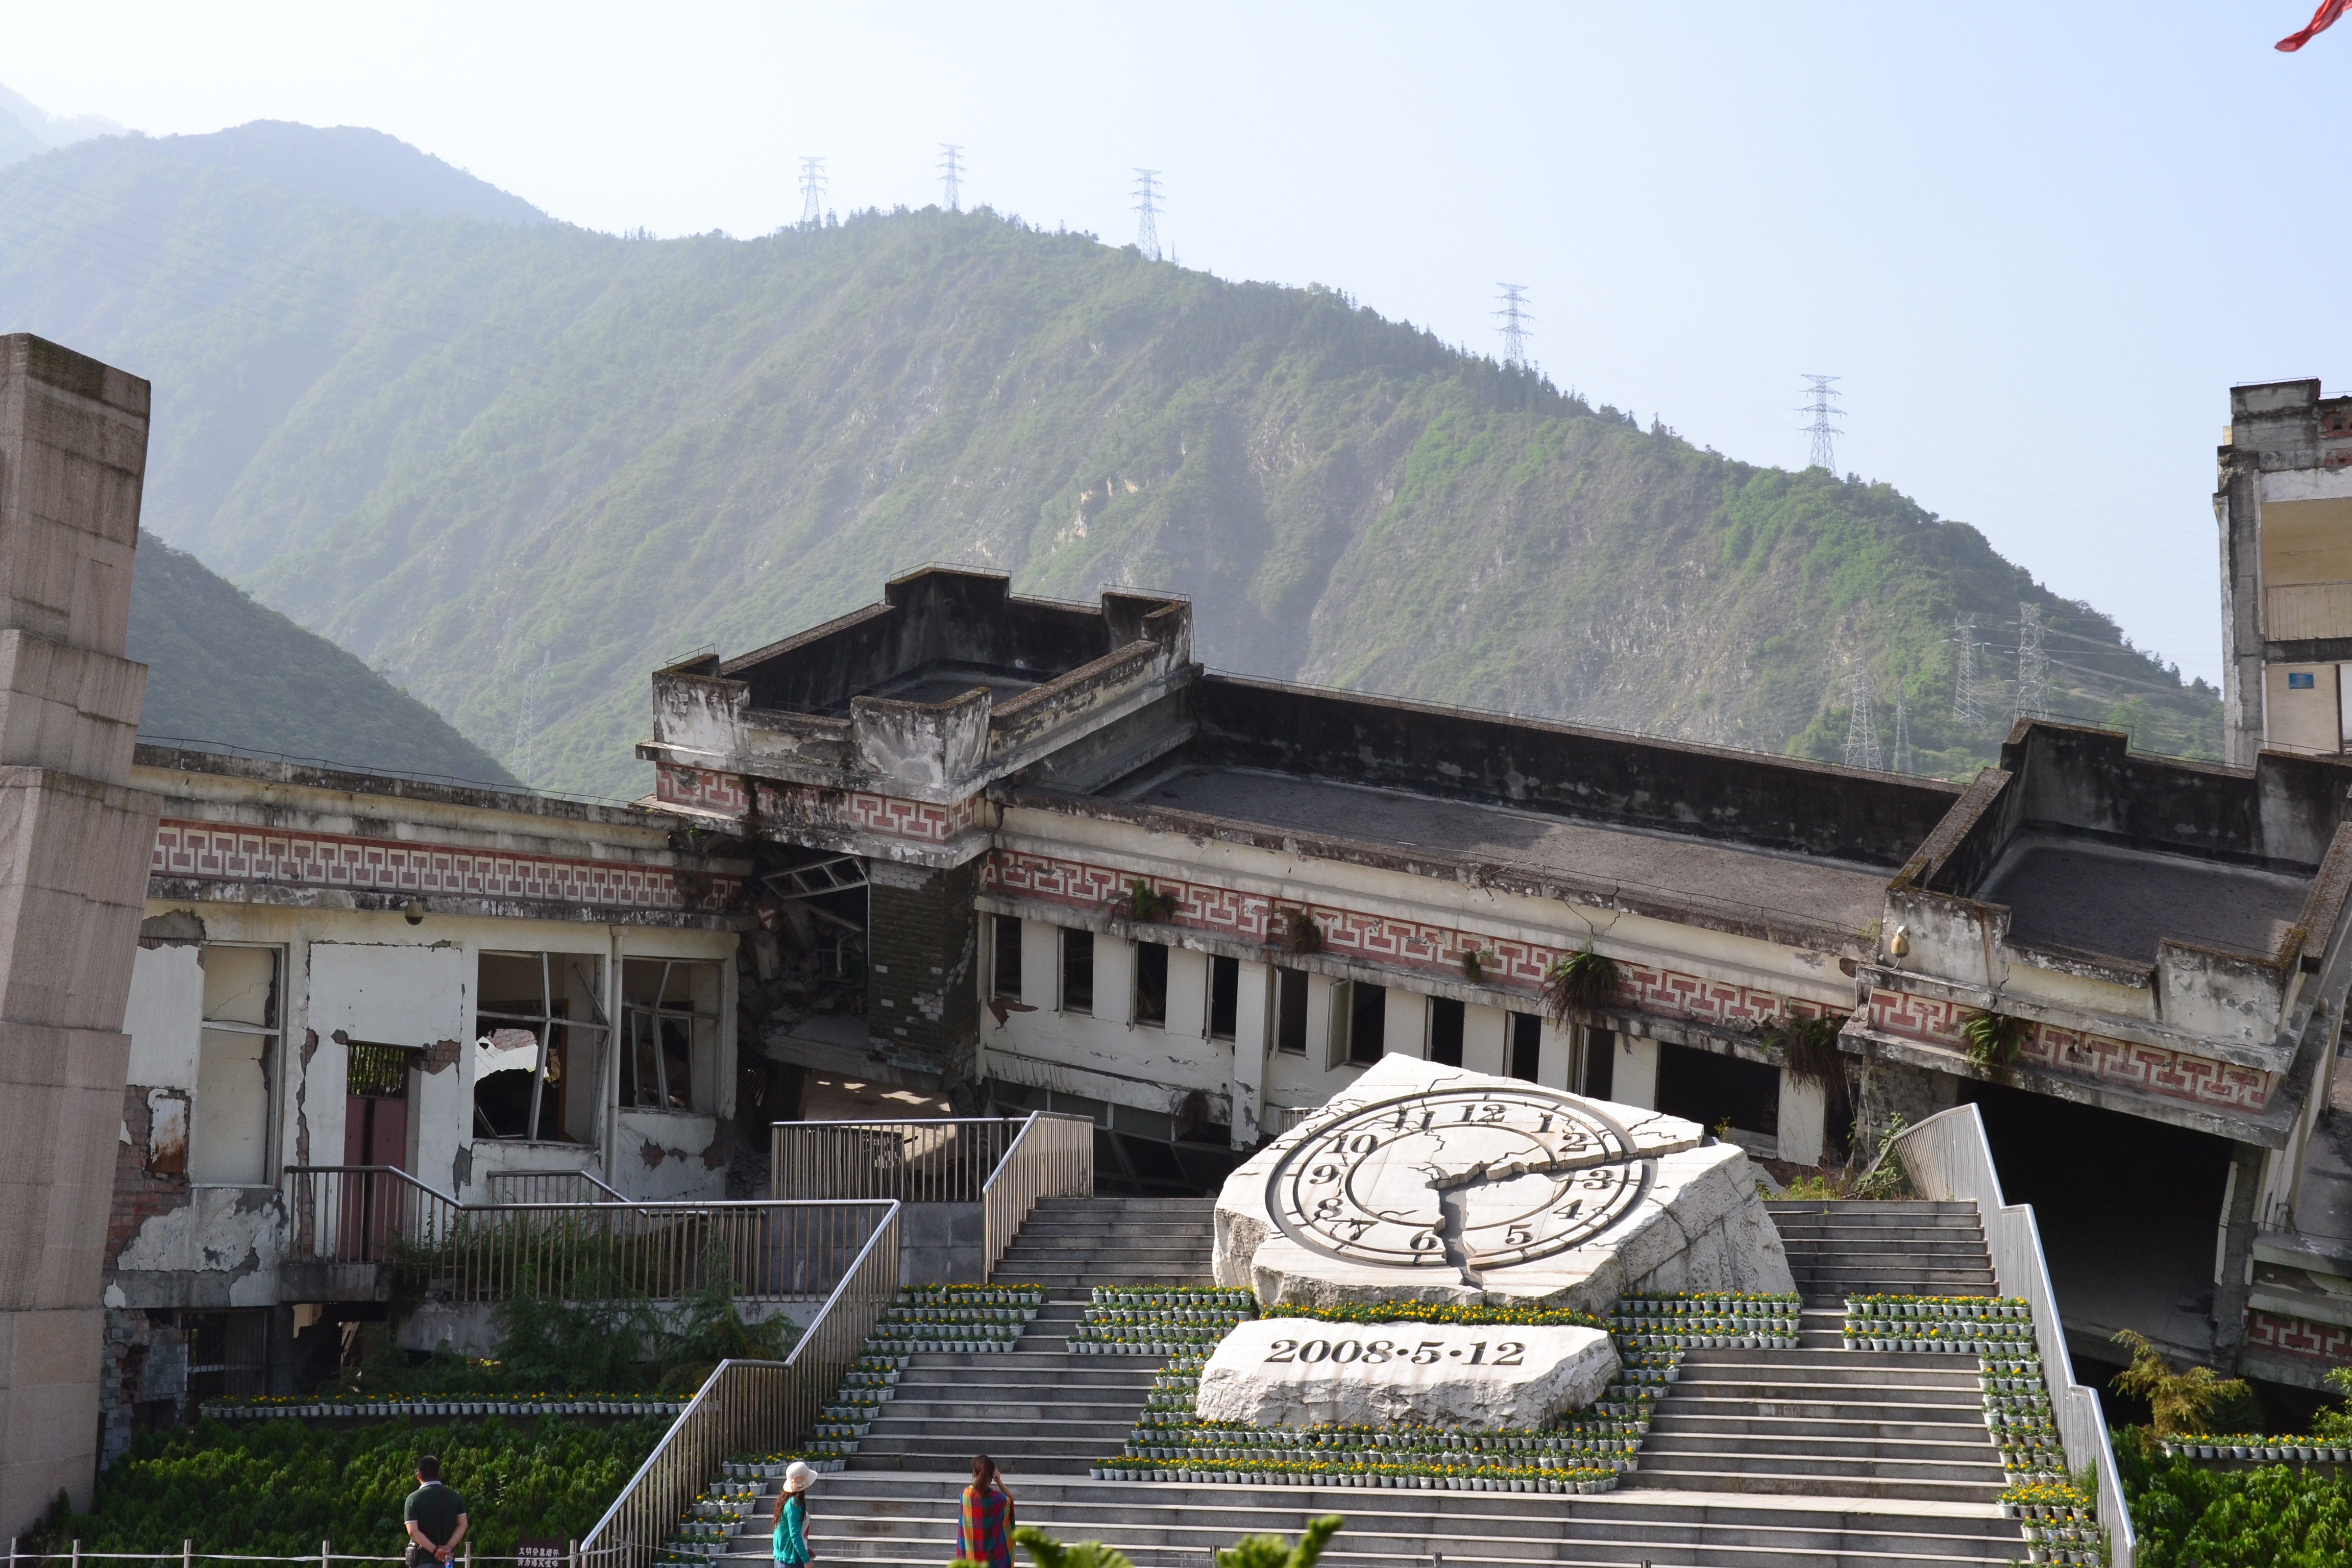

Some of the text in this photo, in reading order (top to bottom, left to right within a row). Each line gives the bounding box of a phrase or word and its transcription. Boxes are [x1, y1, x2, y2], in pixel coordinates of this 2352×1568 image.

[1453, 1104, 1507, 1122] 12
[1531, 1112, 1564, 1133] 1
[1325, 1134, 1379, 1155] 10
[1559, 1132, 1592, 1152] 2
[1309, 1165, 1339, 1184] 9
[1583, 1169, 1615, 1189] 3
[1314, 1198, 1344, 1220] 8
[1552, 1199, 1583, 1220] 4
[1349, 1218, 1380, 1241] 7
[1410, 1229, 1438, 1250] 6
[1505, 1223, 1534, 1244] 5
